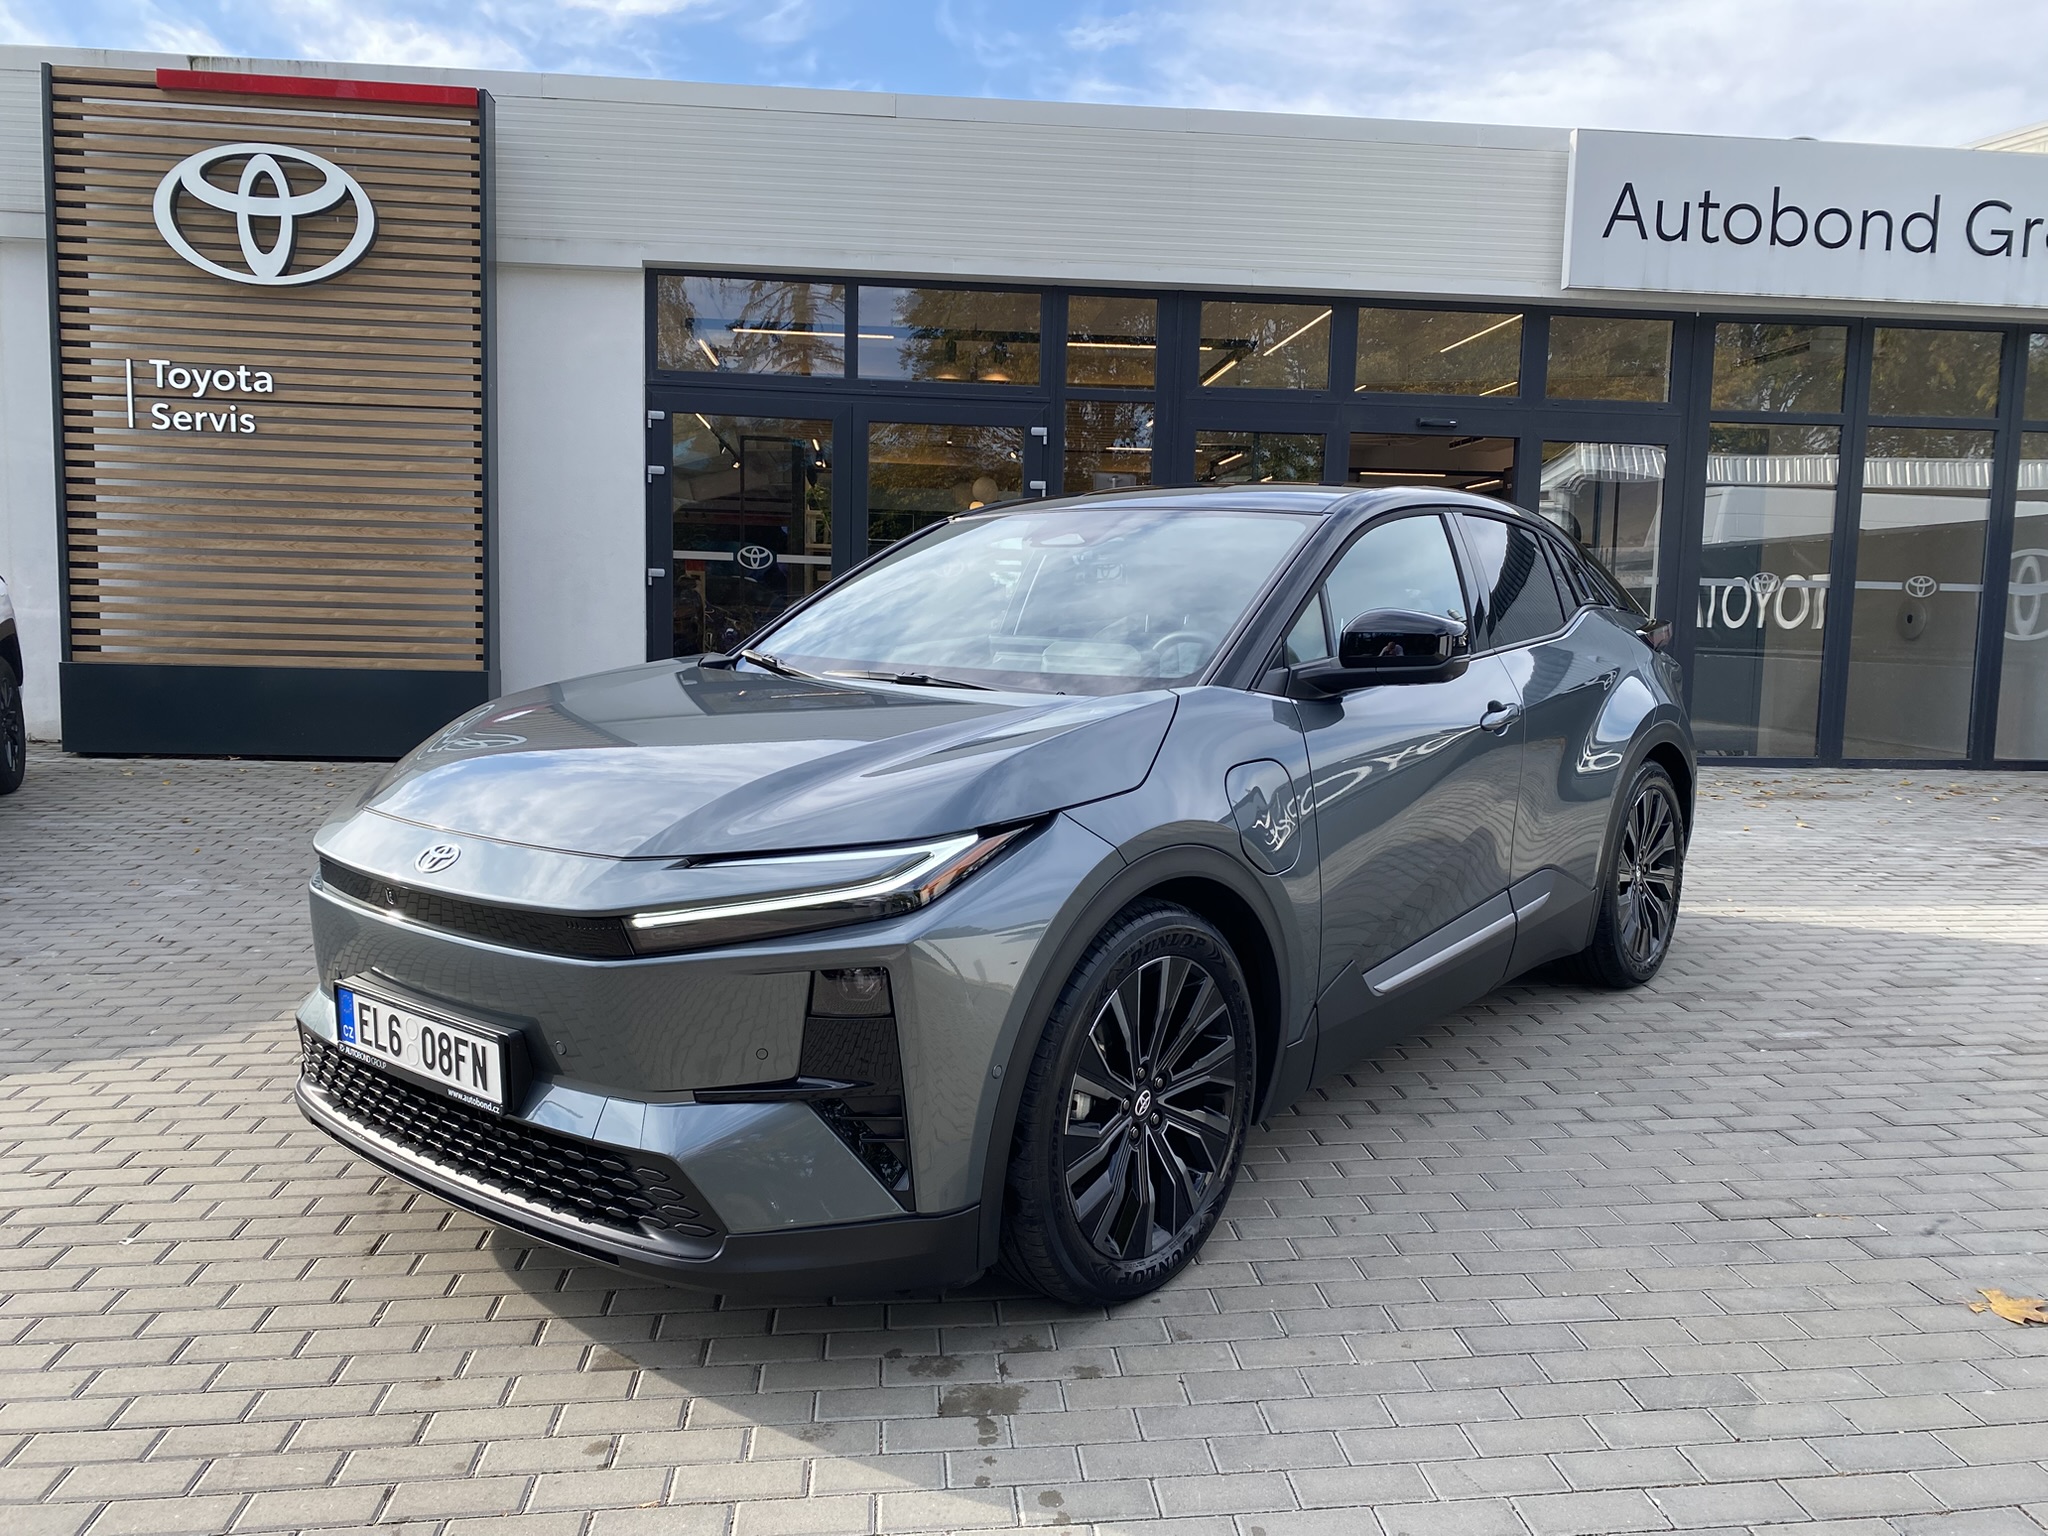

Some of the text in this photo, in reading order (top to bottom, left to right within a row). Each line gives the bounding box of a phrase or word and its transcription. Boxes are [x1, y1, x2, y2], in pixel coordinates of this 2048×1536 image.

[1602, 182, 2048, 258] Autobond Gr
[149, 359, 274, 398] Toyota
[151, 402, 256, 434] Servis
[1130, 932, 1208, 967] DUNLOP
[343, 1024, 354, 1040] CZ
[358, 1002, 488, 1091] EL6 08FN
[344, 1046, 387, 1070] AUTOBOND GROUP
[447, 1087, 501, 1115] www.autobond.cz
[1115, 1234, 1195, 1286] DUNLOP
